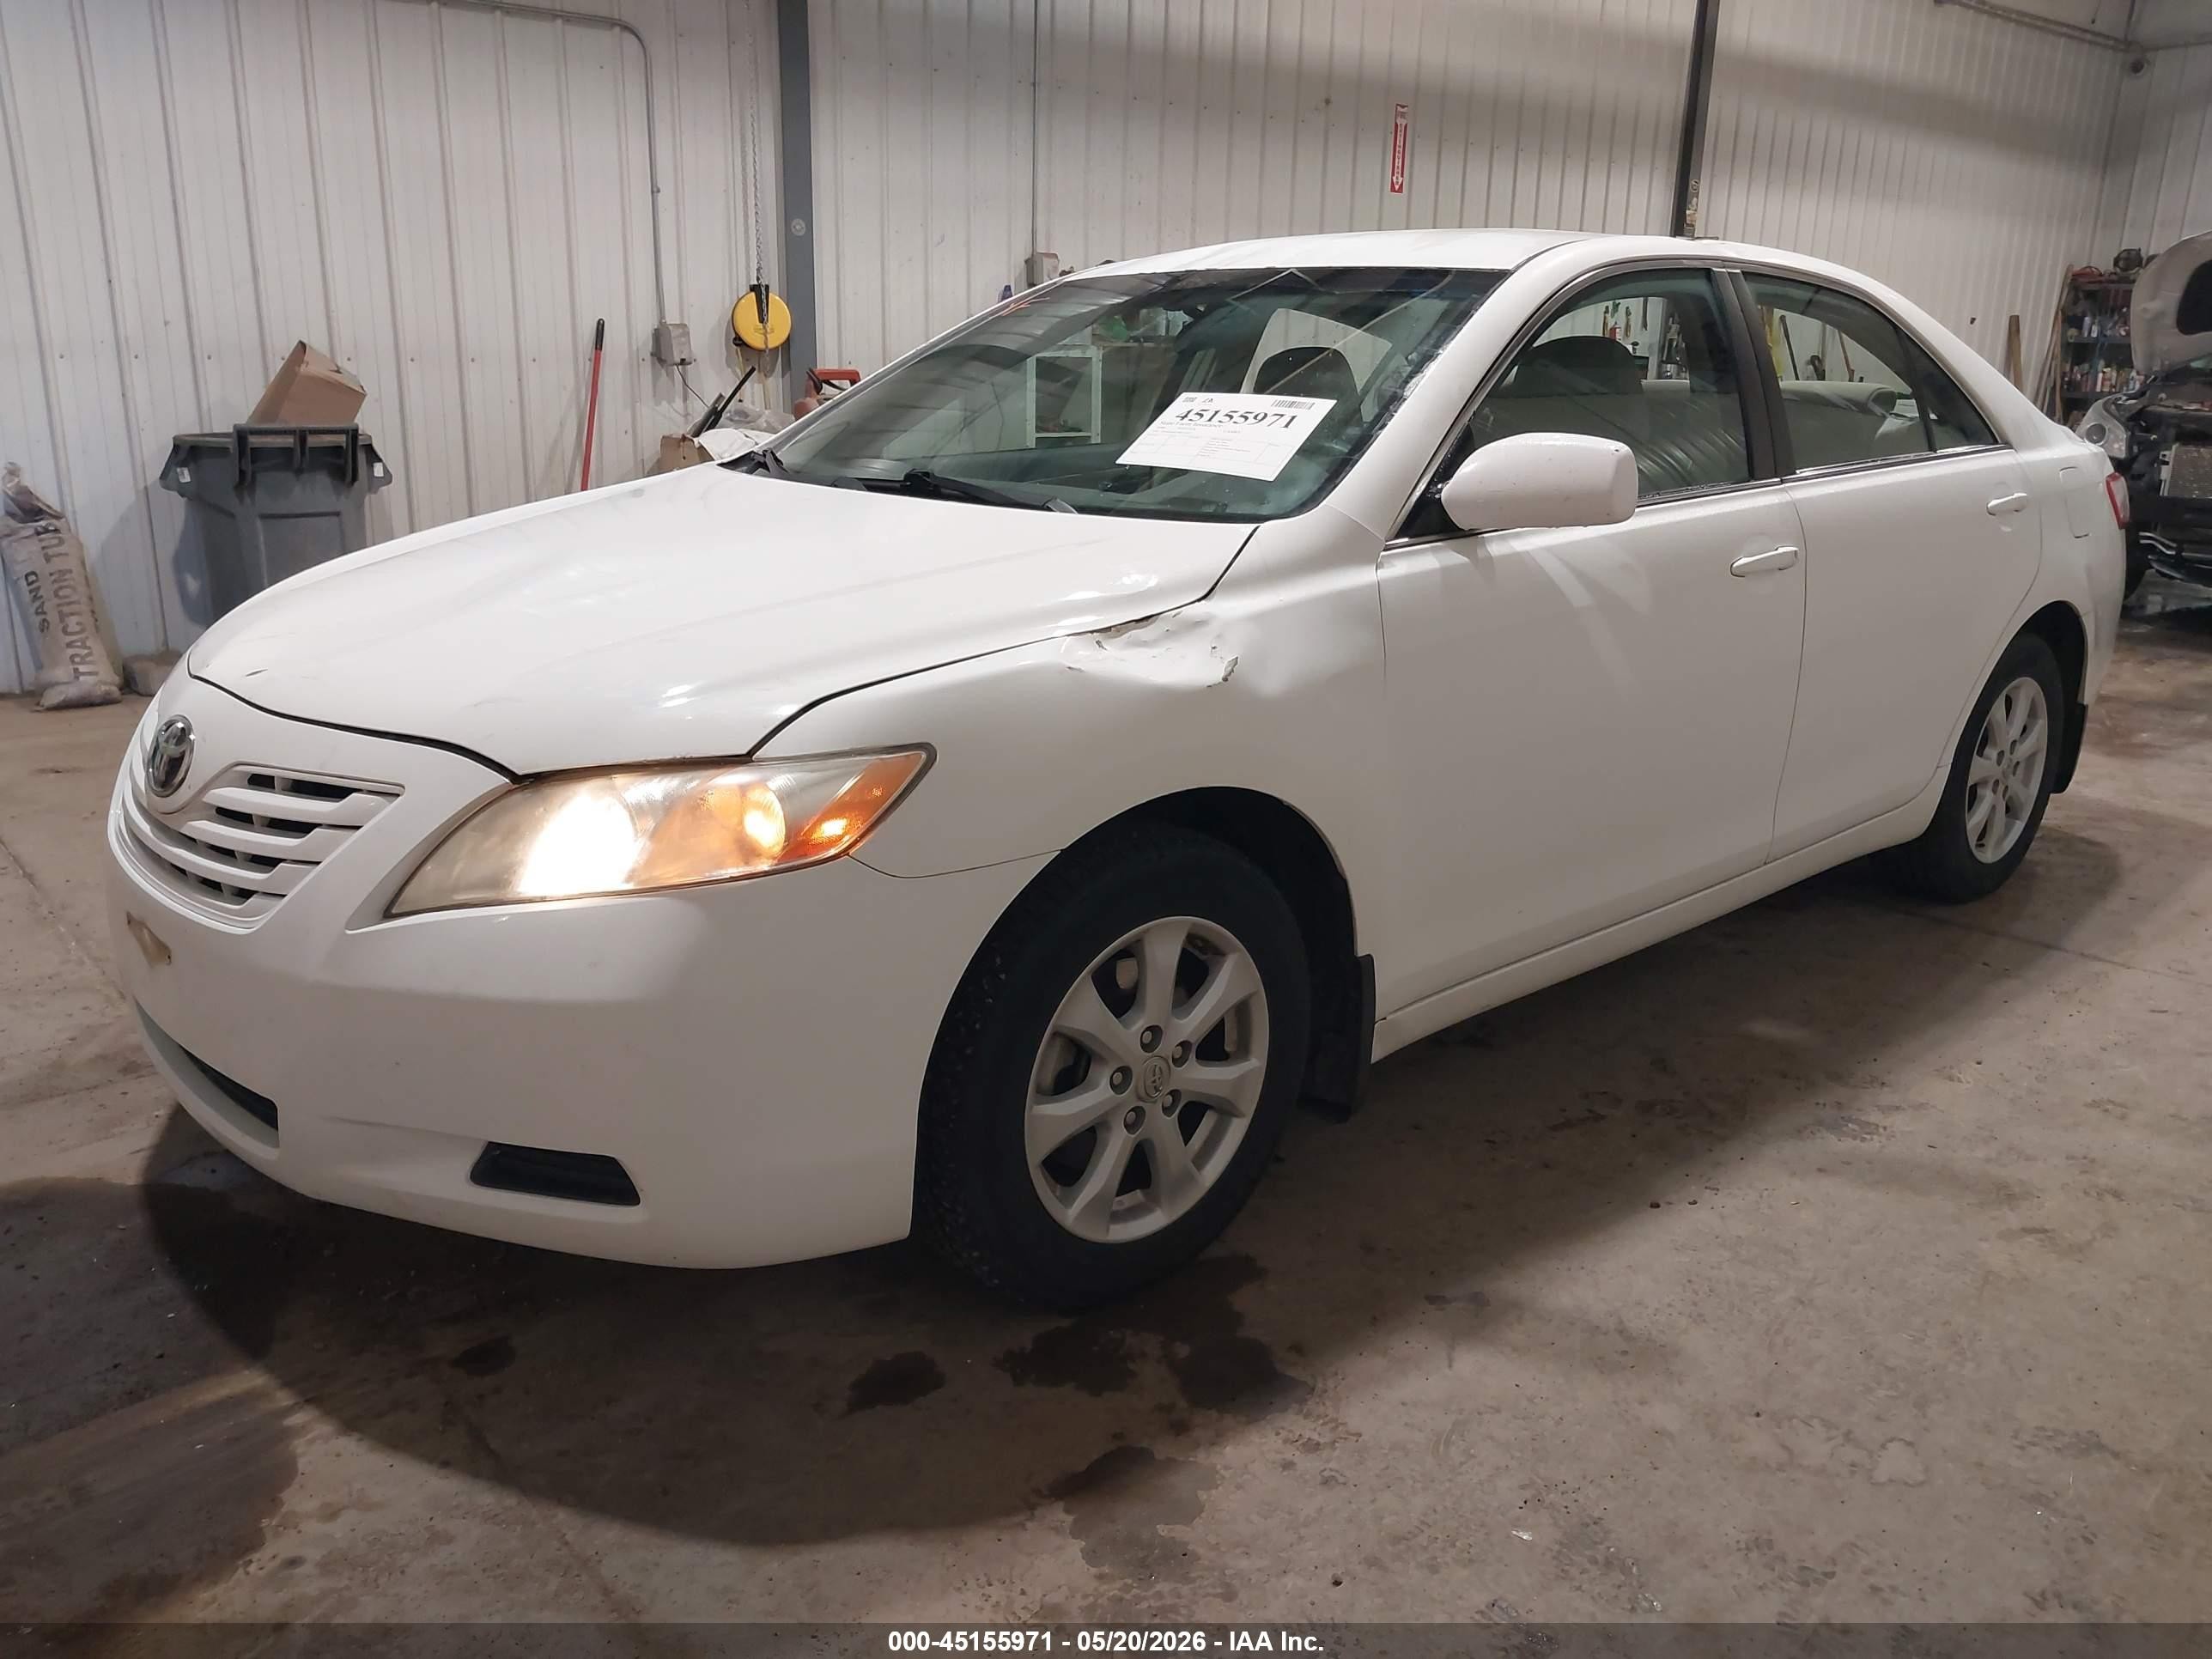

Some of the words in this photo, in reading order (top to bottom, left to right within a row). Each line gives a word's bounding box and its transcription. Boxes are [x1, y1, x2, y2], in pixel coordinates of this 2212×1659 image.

[1176, 408, 1298, 428] 45155971
[24, 570, 50, 634] SAND
[49, 568, 99, 682] TRACTION
